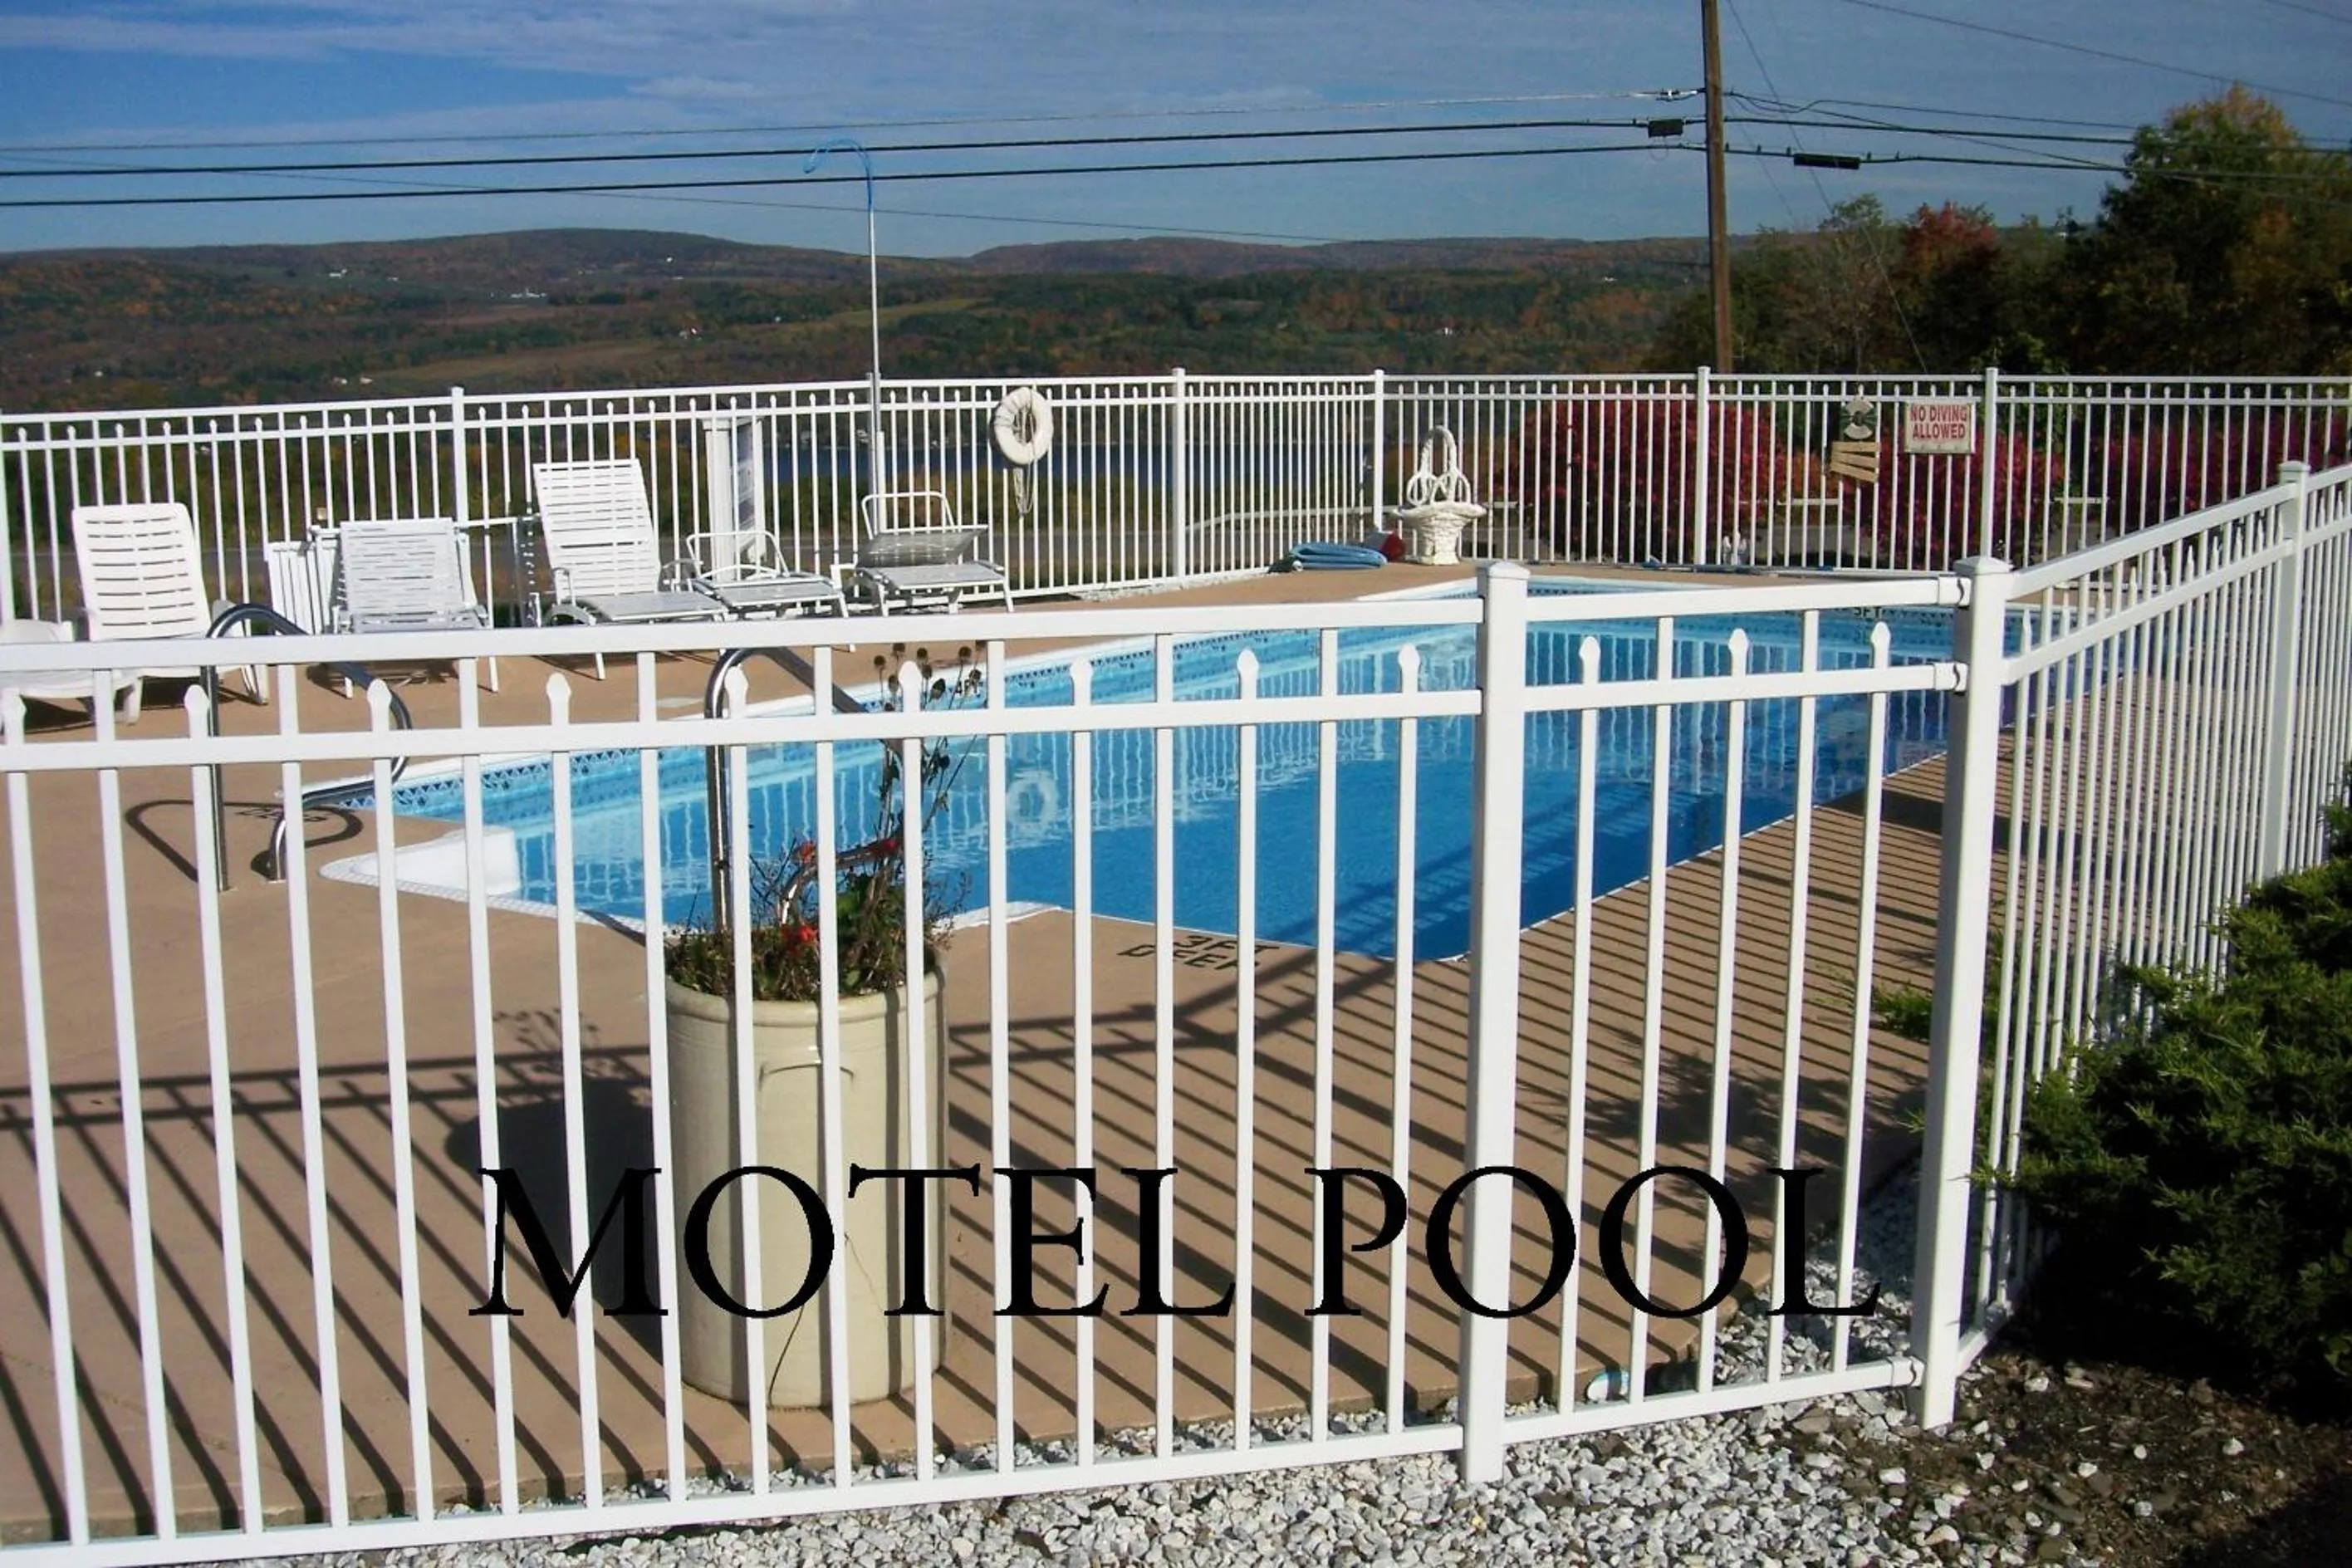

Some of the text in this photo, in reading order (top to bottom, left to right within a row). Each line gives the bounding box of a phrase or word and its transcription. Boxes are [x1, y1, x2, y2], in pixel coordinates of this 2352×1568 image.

[1910, 404, 1967, 422] NO DIVING
[1912, 423, 1966, 439] ALLOWED
